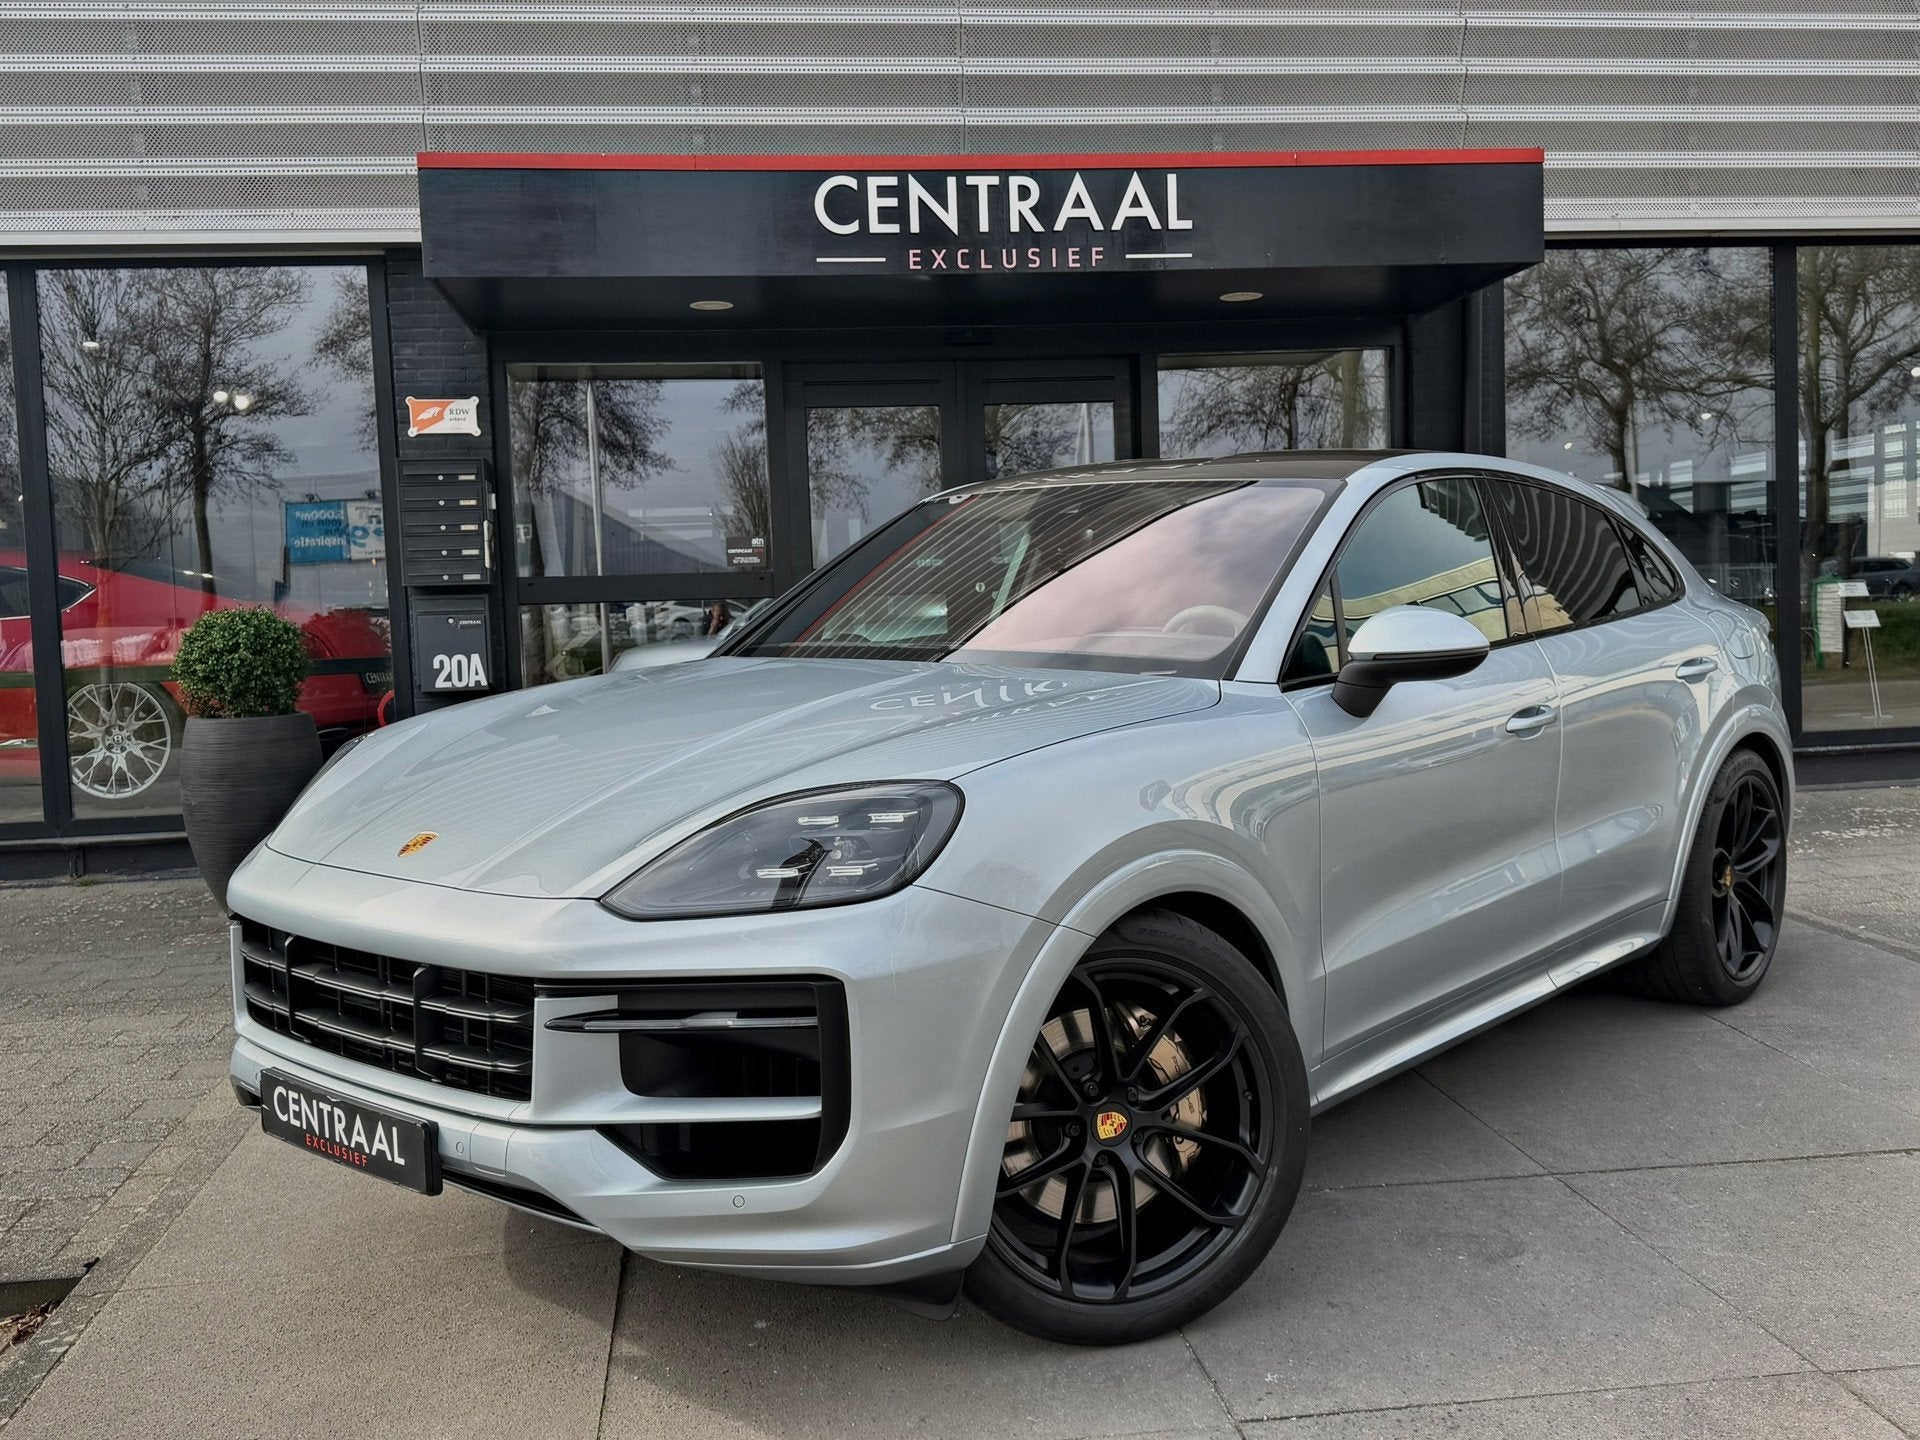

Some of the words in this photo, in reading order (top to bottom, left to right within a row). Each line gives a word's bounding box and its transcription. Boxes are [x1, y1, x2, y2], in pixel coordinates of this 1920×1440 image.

[814, 170, 1193, 236] CENTRAAL
[908, 247, 1104, 270] EXCLUSIEF
[449, 408, 470, 416] RDW
[433, 653, 488, 688] 20A
[273, 1085, 406, 1166] CENTRAAL
[305, 1133, 368, 1167] EXCLUSIEF
